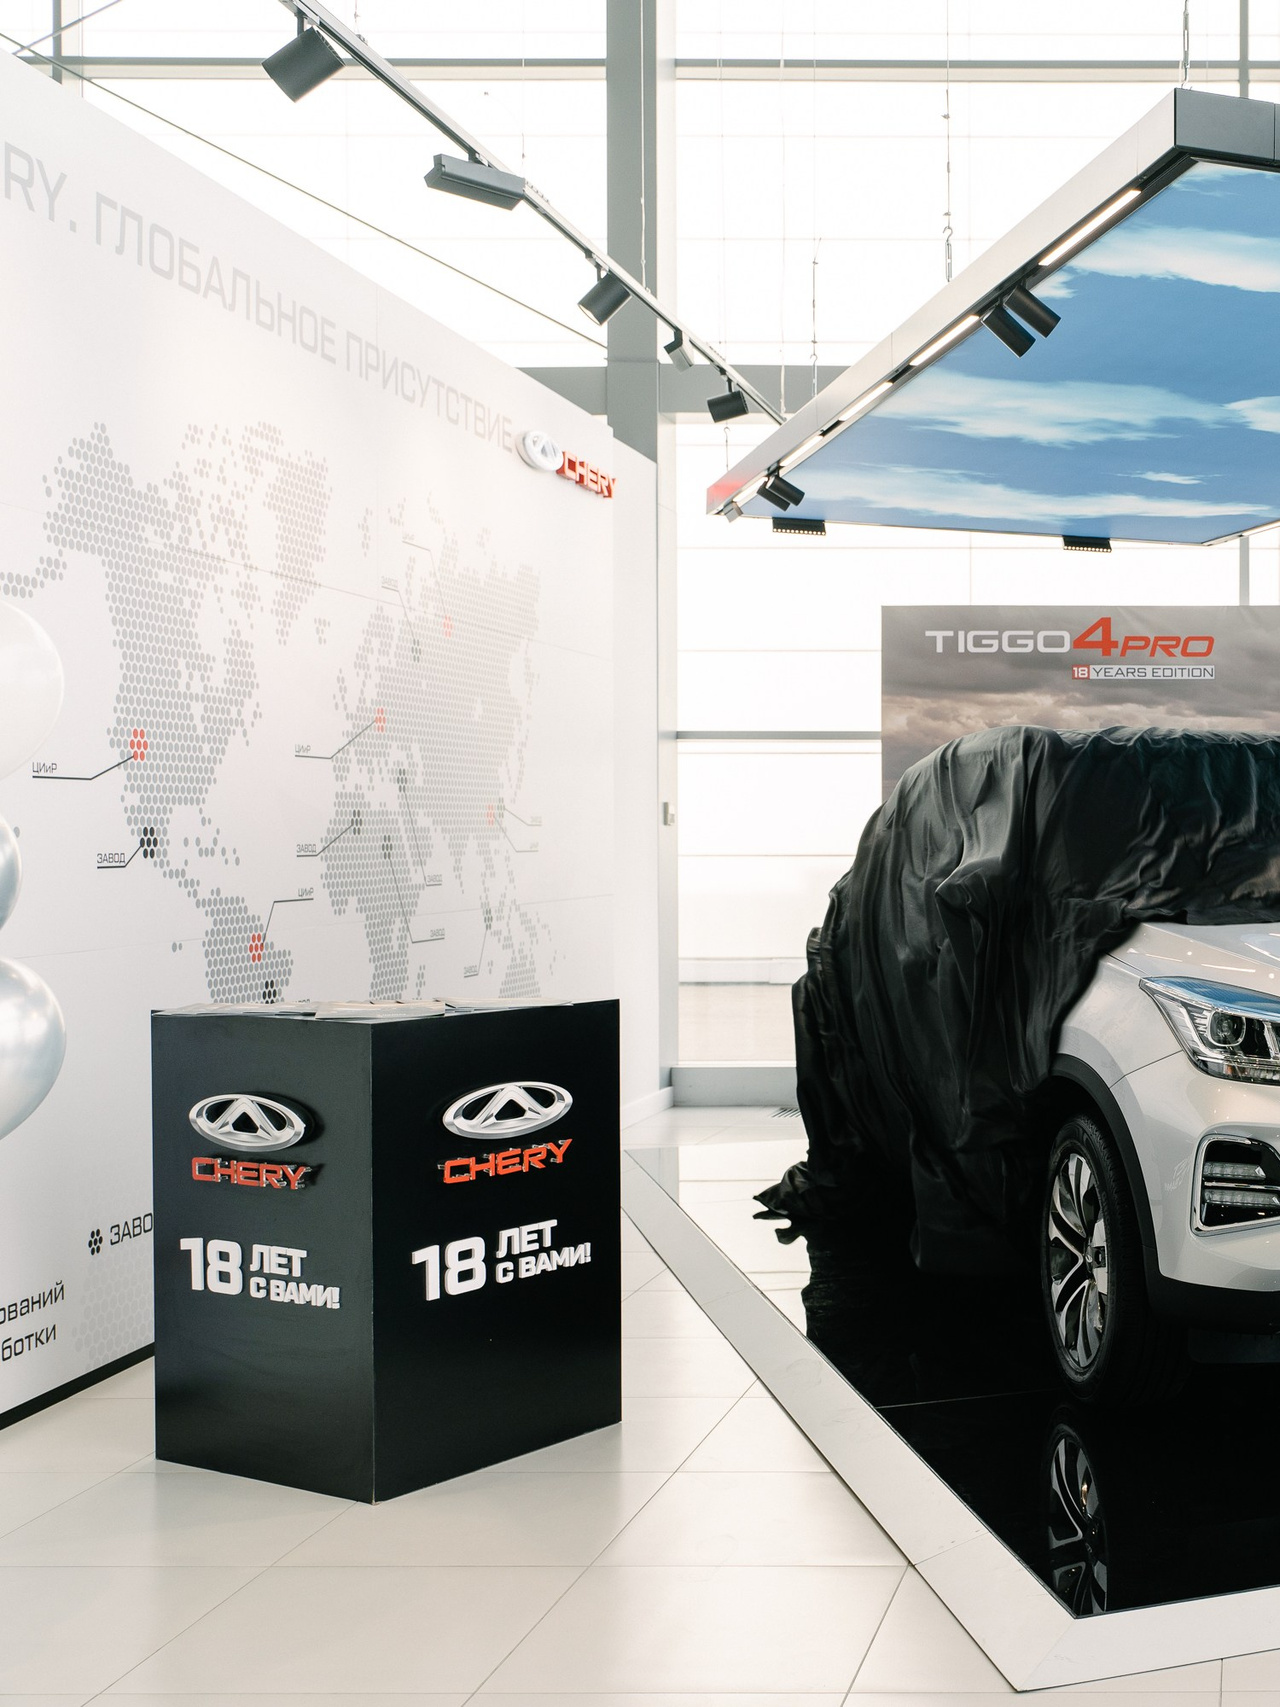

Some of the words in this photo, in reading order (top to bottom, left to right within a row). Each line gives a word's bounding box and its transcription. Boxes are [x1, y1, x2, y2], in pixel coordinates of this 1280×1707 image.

[95, 191, 336, 365] ГЛОБАЛЬНОЕ
[346, 330, 513, 453] ПРИСУТСТВИЕ
[557, 451, 617, 498] CHERY
[1072, 666, 1088, 679] 18
[1092, 667, 1147, 678] YEARS
[1151, 666, 1214, 678] EDITION
[96, 852, 126, 865] ЗАВОД
[191, 1156, 308, 1190] CHERY
[443, 1138, 573, 1184] CHERY
[110, 1212, 153, 1246] ЗАВО
[180, 1237, 243, 1295] 18
[250, 1243, 307, 1277] ЛЕТ
[411, 1236, 487, 1301] 18
[496, 1219, 558, 1258] ЛЕТ
[495, 1261, 514, 1283] С
[518, 1242, 591, 1279] ВАМИ!
[250, 1277, 267, 1299] С
[269, 1279, 340, 1309] ВАМИ!
[1, 1324, 57, 1362] ботки
